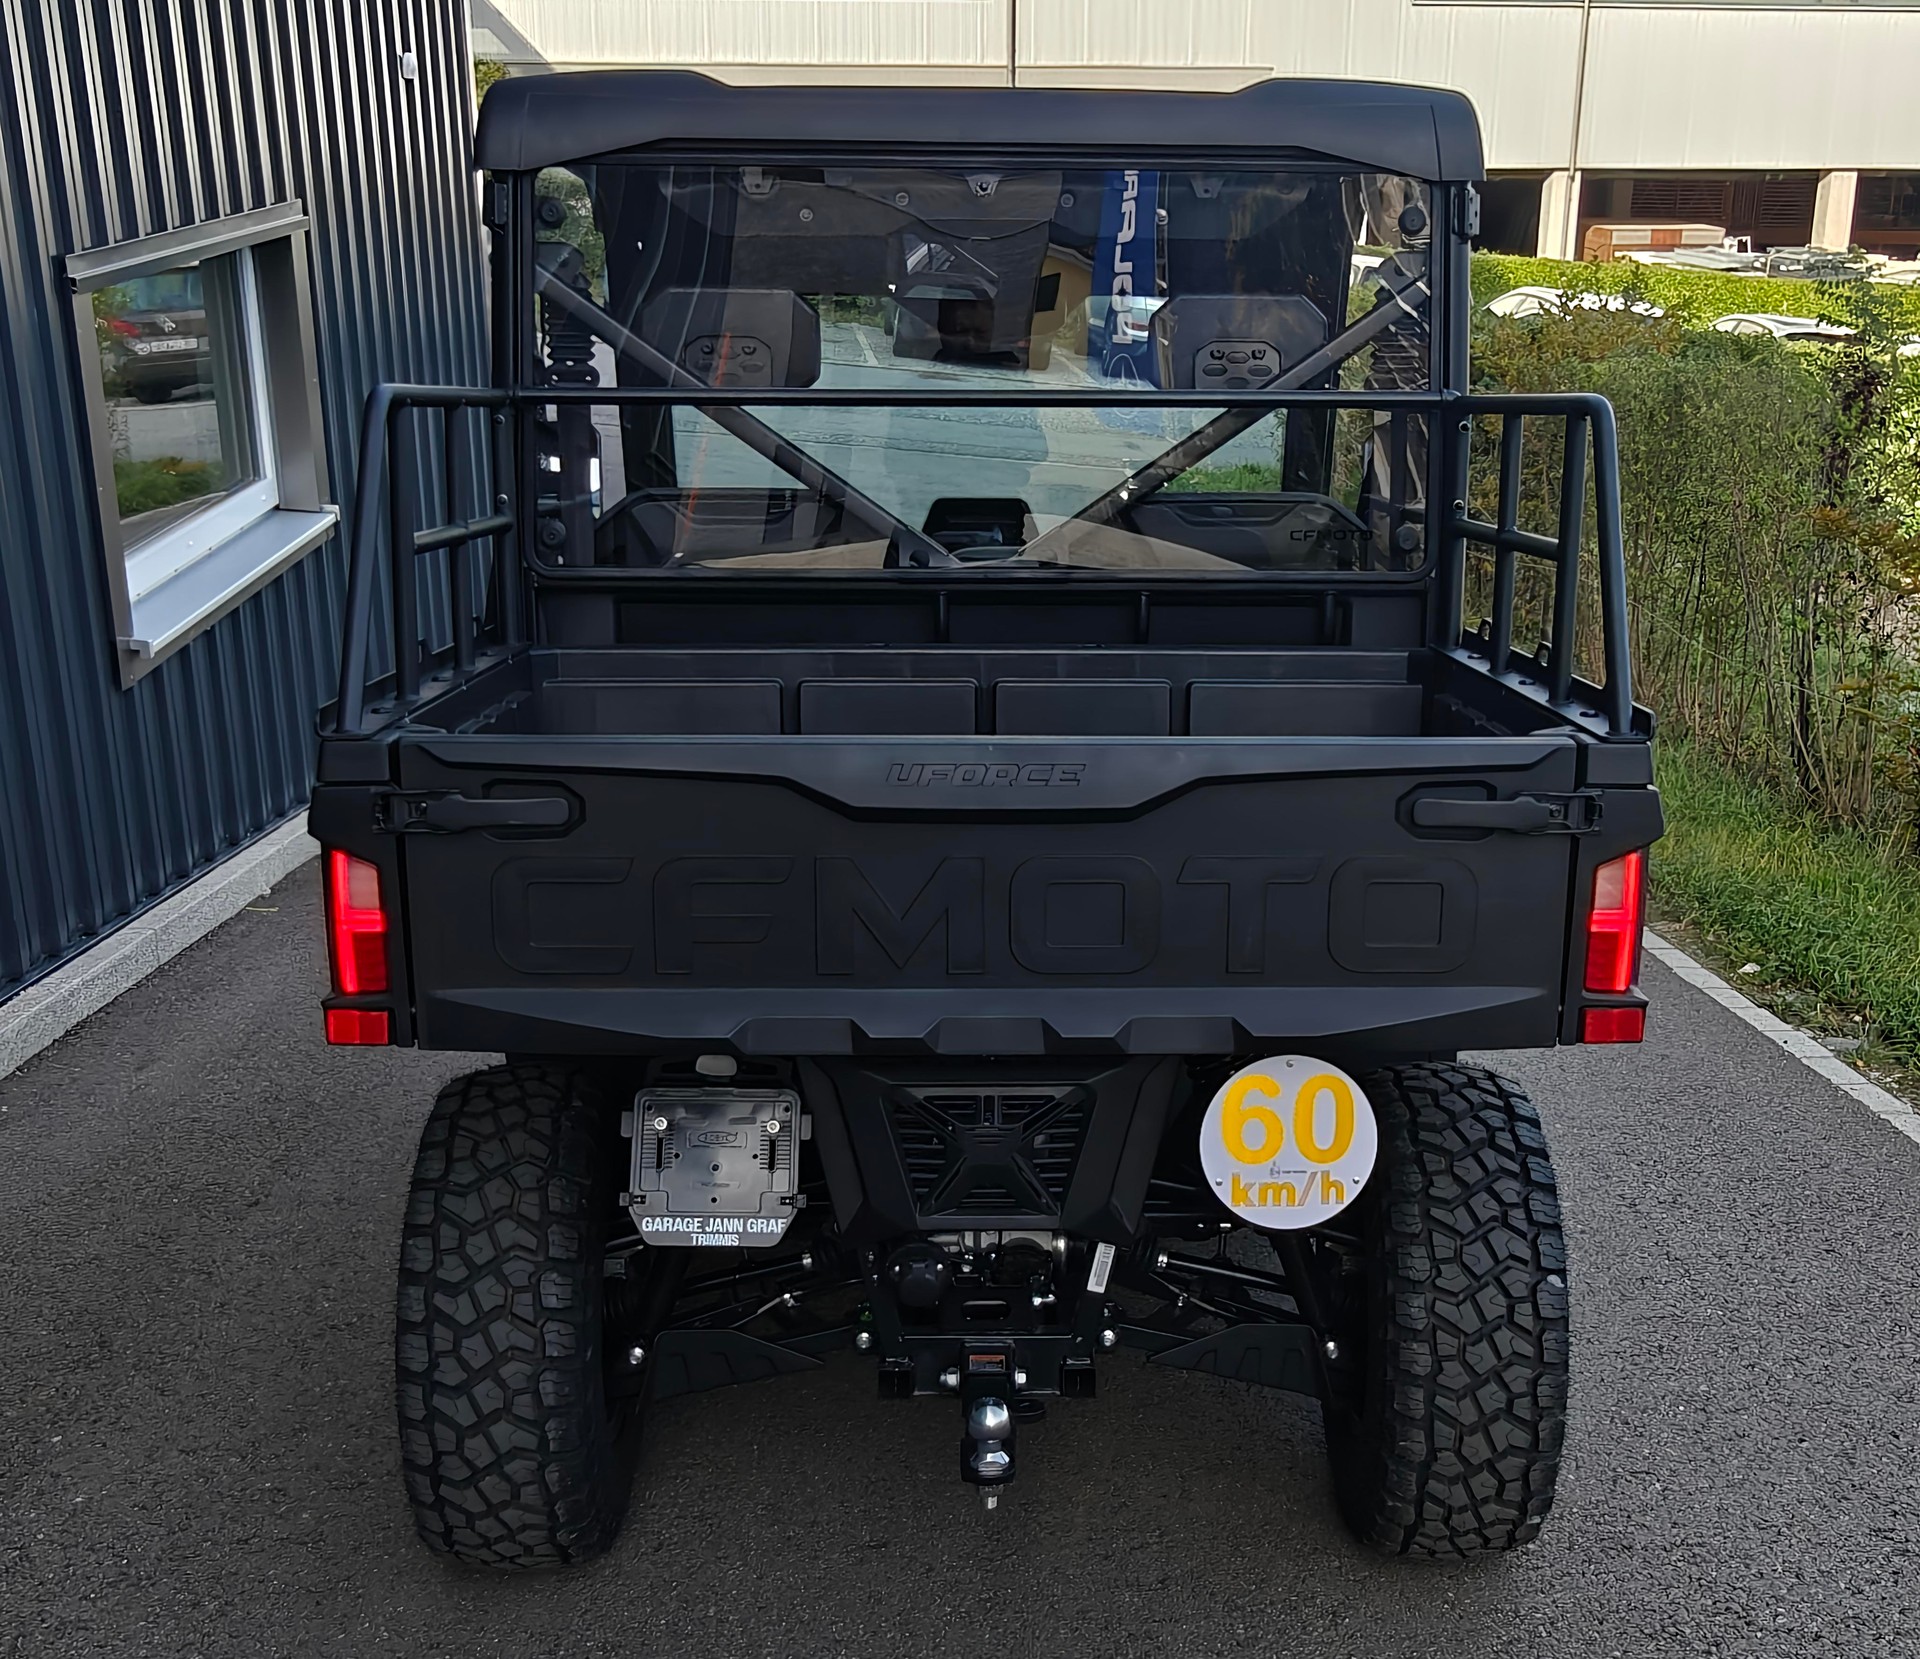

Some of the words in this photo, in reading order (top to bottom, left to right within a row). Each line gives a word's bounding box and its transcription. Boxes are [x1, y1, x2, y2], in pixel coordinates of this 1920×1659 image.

[886, 763, 1087, 787] UFORCE
[491, 855, 1479, 974] CFMOTO
[1222, 1074, 1355, 1164] 60
[1231, 1171, 1345, 1207] km/h
[641, 1217, 703, 1232] GARAGE
[705, 1218, 743, 1233] JANN
[747, 1219, 788, 1234] GRAF
[690, 1234, 739, 1246] TRIMMIS
